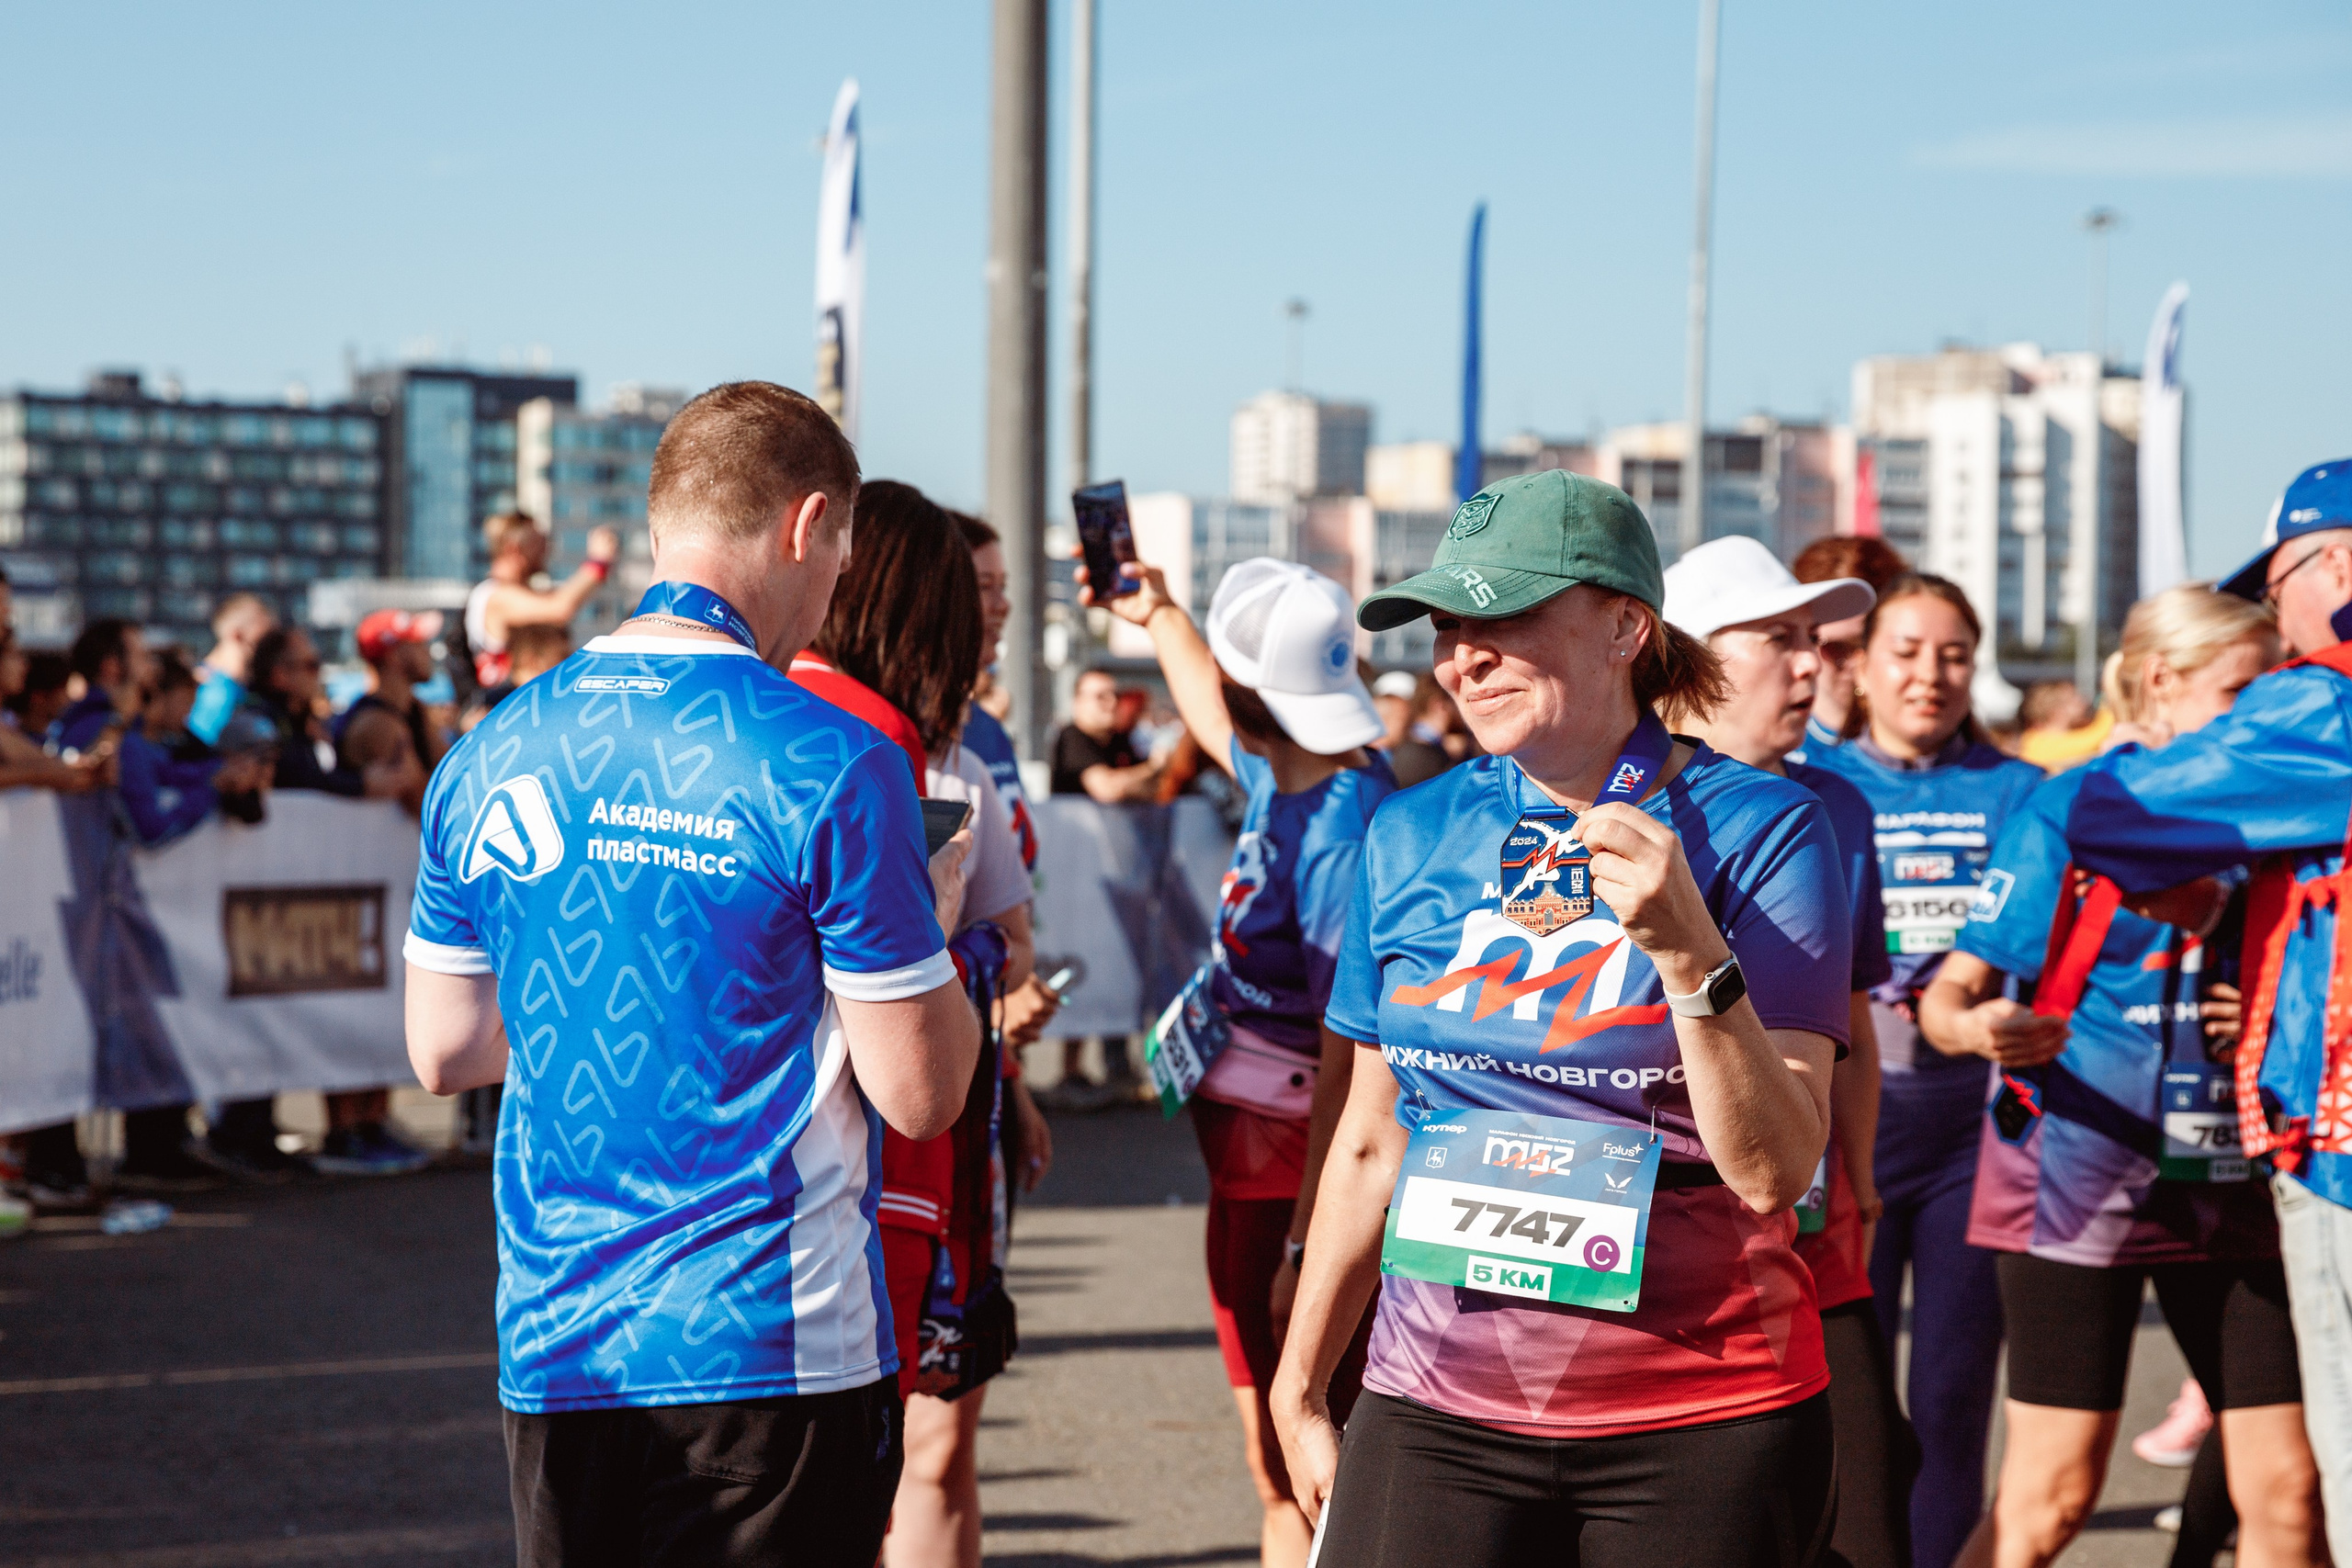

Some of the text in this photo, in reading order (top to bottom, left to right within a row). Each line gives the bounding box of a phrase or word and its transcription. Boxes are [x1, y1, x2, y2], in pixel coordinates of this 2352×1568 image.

[579, 679, 665, 693] ESCAPER
[587, 796, 736, 841] Академия
[1510, 836, 1539, 846] 2024
[586, 838, 738, 878] пластмасс
[1505, 1060, 1686, 1090] НОВГОРО
[1421, 1124, 1468, 1134] купер
[1488, 1129, 1519, 1137] МАРАФОН
[1602, 1142, 1635, 1157] Fplus
[1451, 1197, 1587, 1248] 7747
[1590, 1241, 1613, 1266] C
[1472, 1263, 1546, 1292] 5 KM
